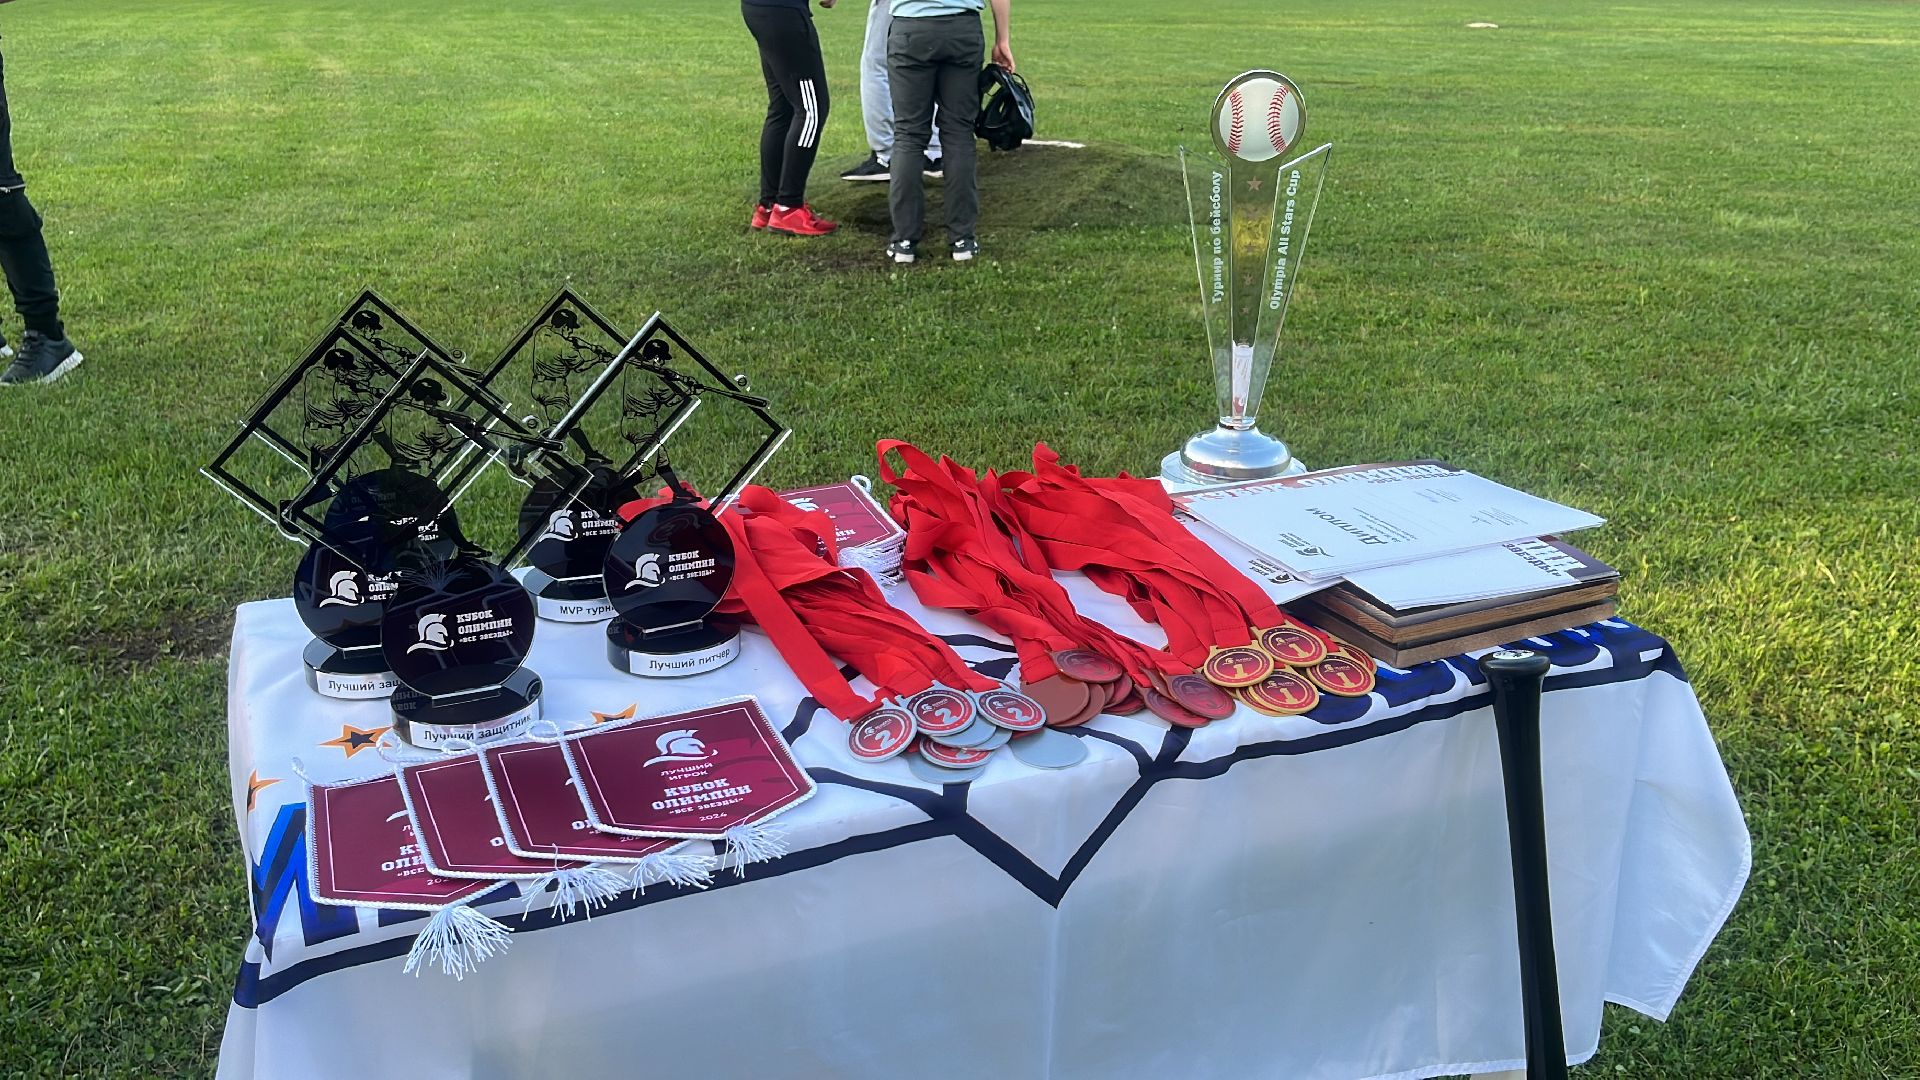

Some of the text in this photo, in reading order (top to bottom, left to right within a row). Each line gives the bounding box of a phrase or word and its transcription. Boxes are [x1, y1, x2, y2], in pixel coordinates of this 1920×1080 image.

[1210, 171, 1225, 304] Турнир по бейсболу
[1269, 169, 1301, 310] Olympia All Stars Cup
[1305, 507, 1388, 545] Диплом
[668, 550, 700, 562] КУБОК
[668, 558, 715, 572] ОЛИМПИИ
[456, 609, 493, 623] КУБОК
[559, 604, 614, 616] MVP турн
[458, 617, 512, 635] ОЛИМПИИ
[1288, 643, 1309, 657] 1
[648, 648, 731, 671] Лучший питчер
[1233, 664, 1249, 679] 1
[1336, 672, 1356, 687] 1
[328, 679, 376, 692] Лучший
[1280, 688, 1299, 704] 1
[934, 708, 959, 725] 2
[1007, 707, 1032, 723] 2
[478, 714, 531, 739] защитник
[875, 730, 896, 749] 2
[660, 762, 714, 777] ЛУЧШИЙ
[668, 770, 709, 781] ИГРОК
[663, 778, 730, 797] КУБОК
[651, 785, 753, 811] ОЛИМПИИ
[698, 812, 729, 822] 2024
